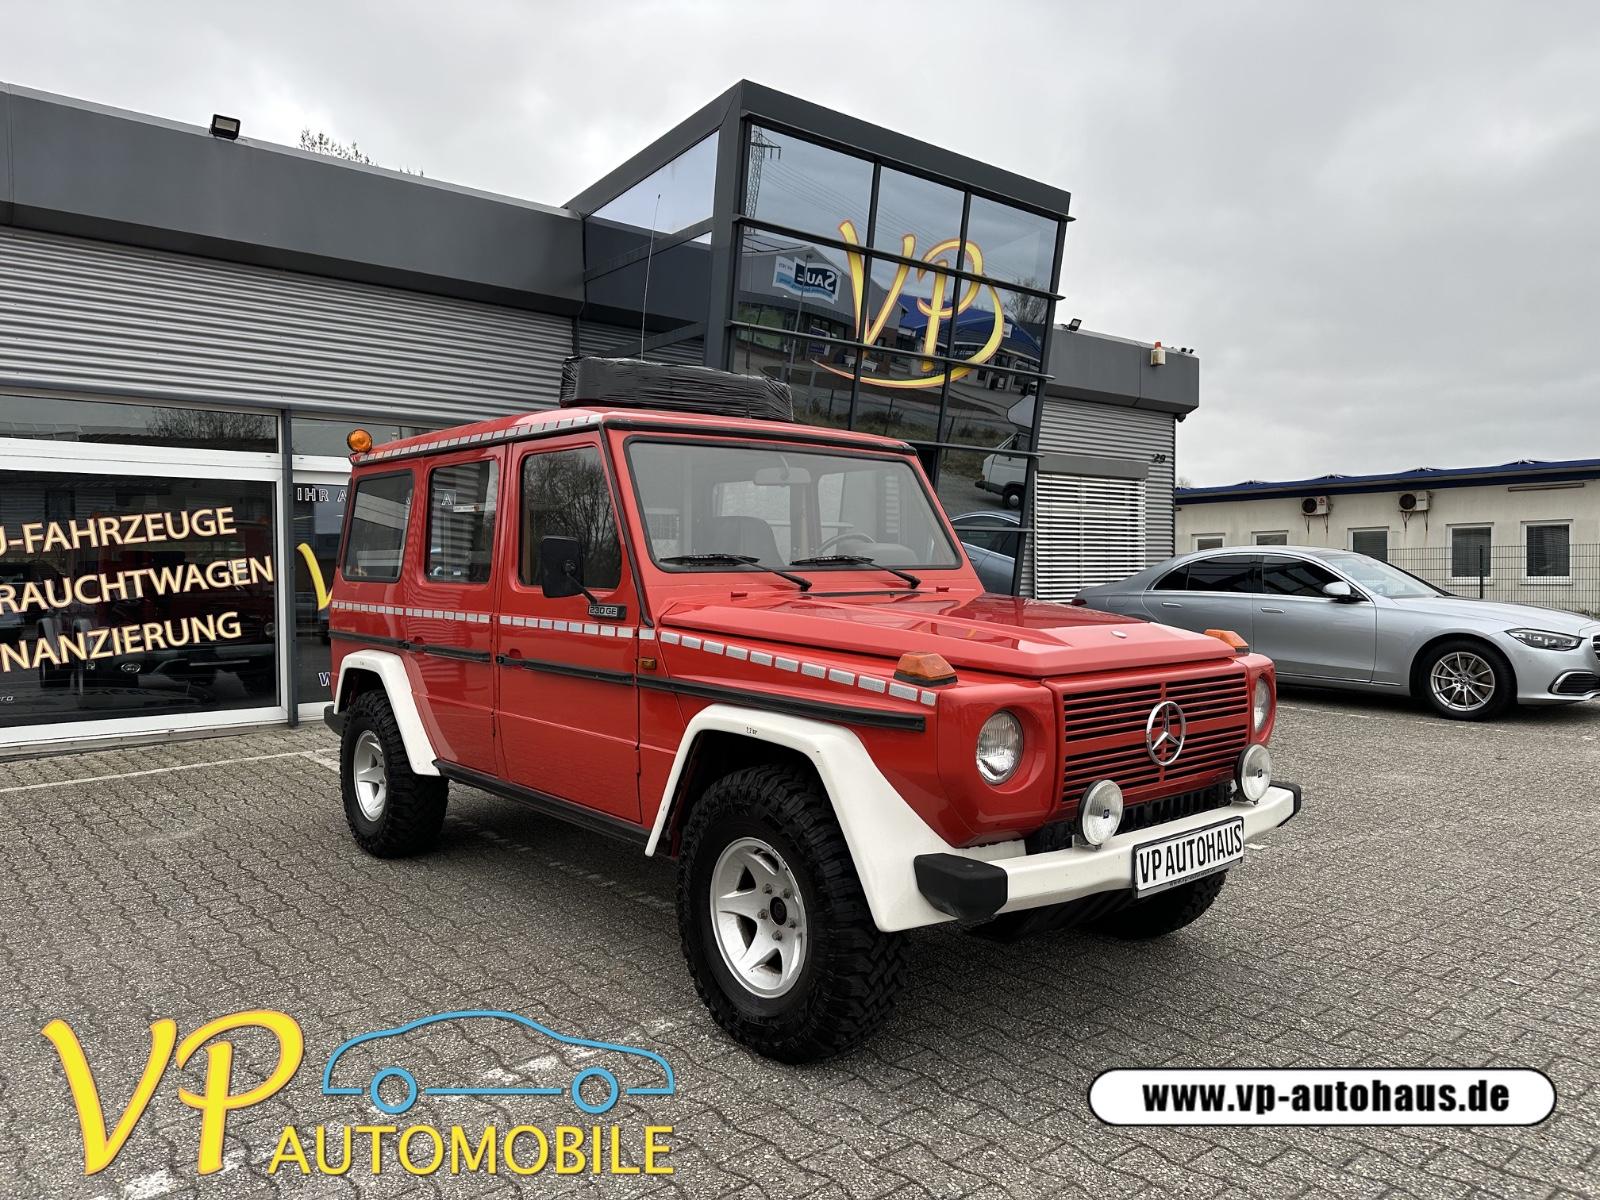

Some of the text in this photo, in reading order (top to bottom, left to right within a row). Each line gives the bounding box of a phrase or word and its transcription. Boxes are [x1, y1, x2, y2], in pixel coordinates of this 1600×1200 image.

[838, 219, 985, 373] VP
[1152, 453, 1167, 464] 29
[297, 487, 330, 502] IHR
[0, 506, 238, 554] -FAHRZEUGE
[0, 611, 243, 673] NANZIERUNG
[1139, 849, 1162, 884] VP
[1165, 823, 1243, 877] AUTOHAUS
